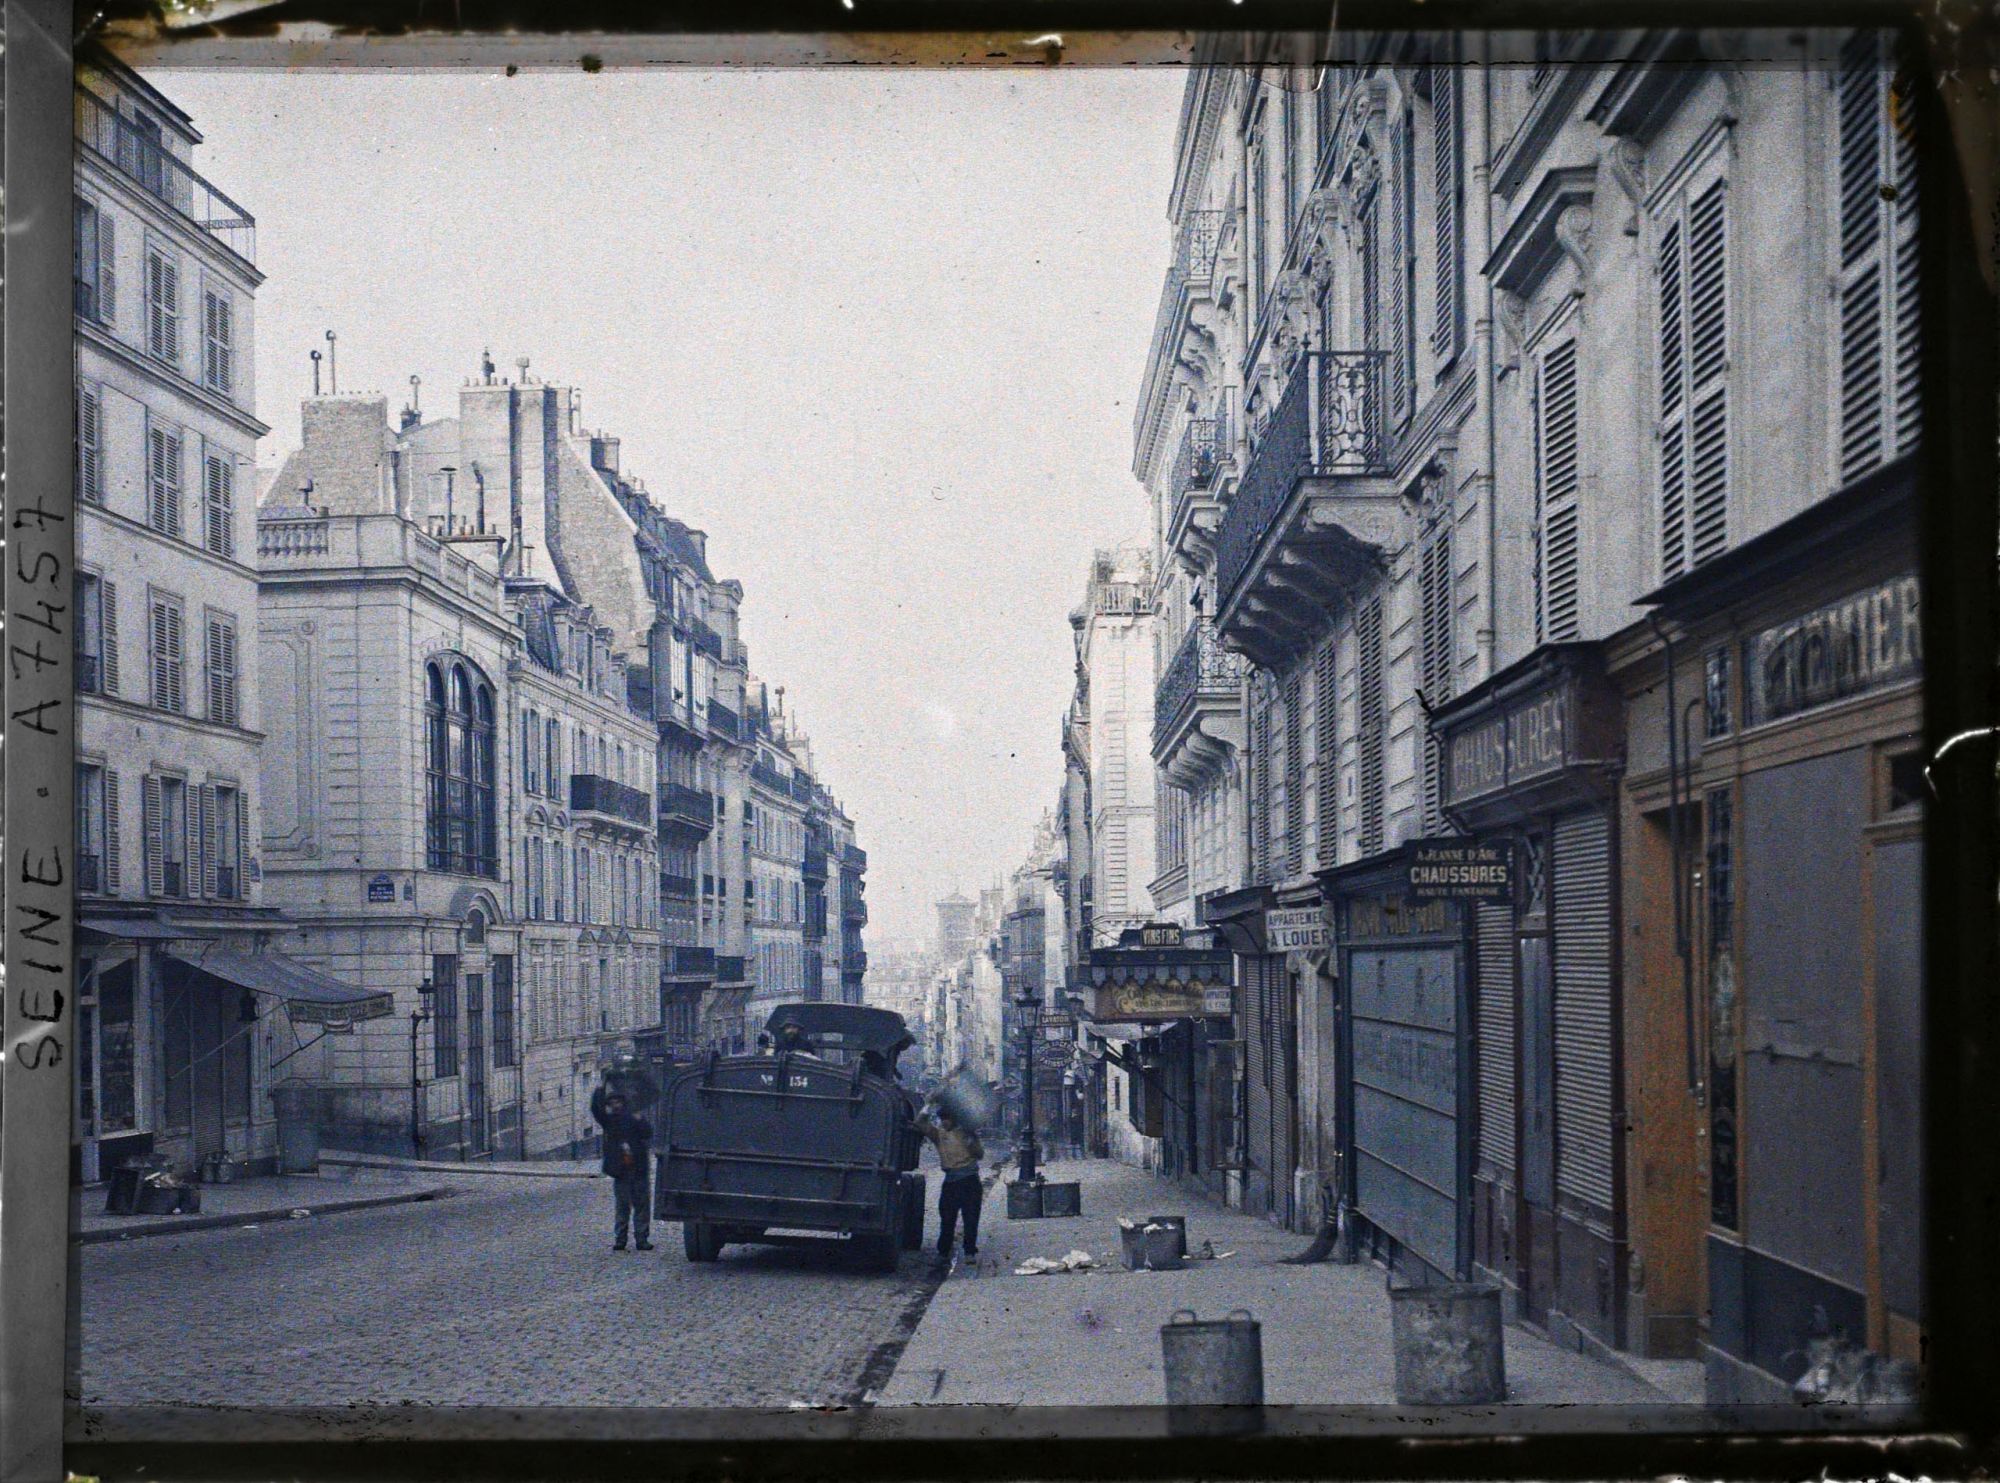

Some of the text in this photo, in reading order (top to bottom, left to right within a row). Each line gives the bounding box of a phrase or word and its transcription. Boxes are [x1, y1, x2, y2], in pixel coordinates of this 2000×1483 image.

[1410, 865, 1507, 883] CHAUSSURES
[1142, 928, 1180, 945] VINS FINS
[1283, 928, 1330, 946] LOUER
[14, 844, 65, 1071] SEINE
